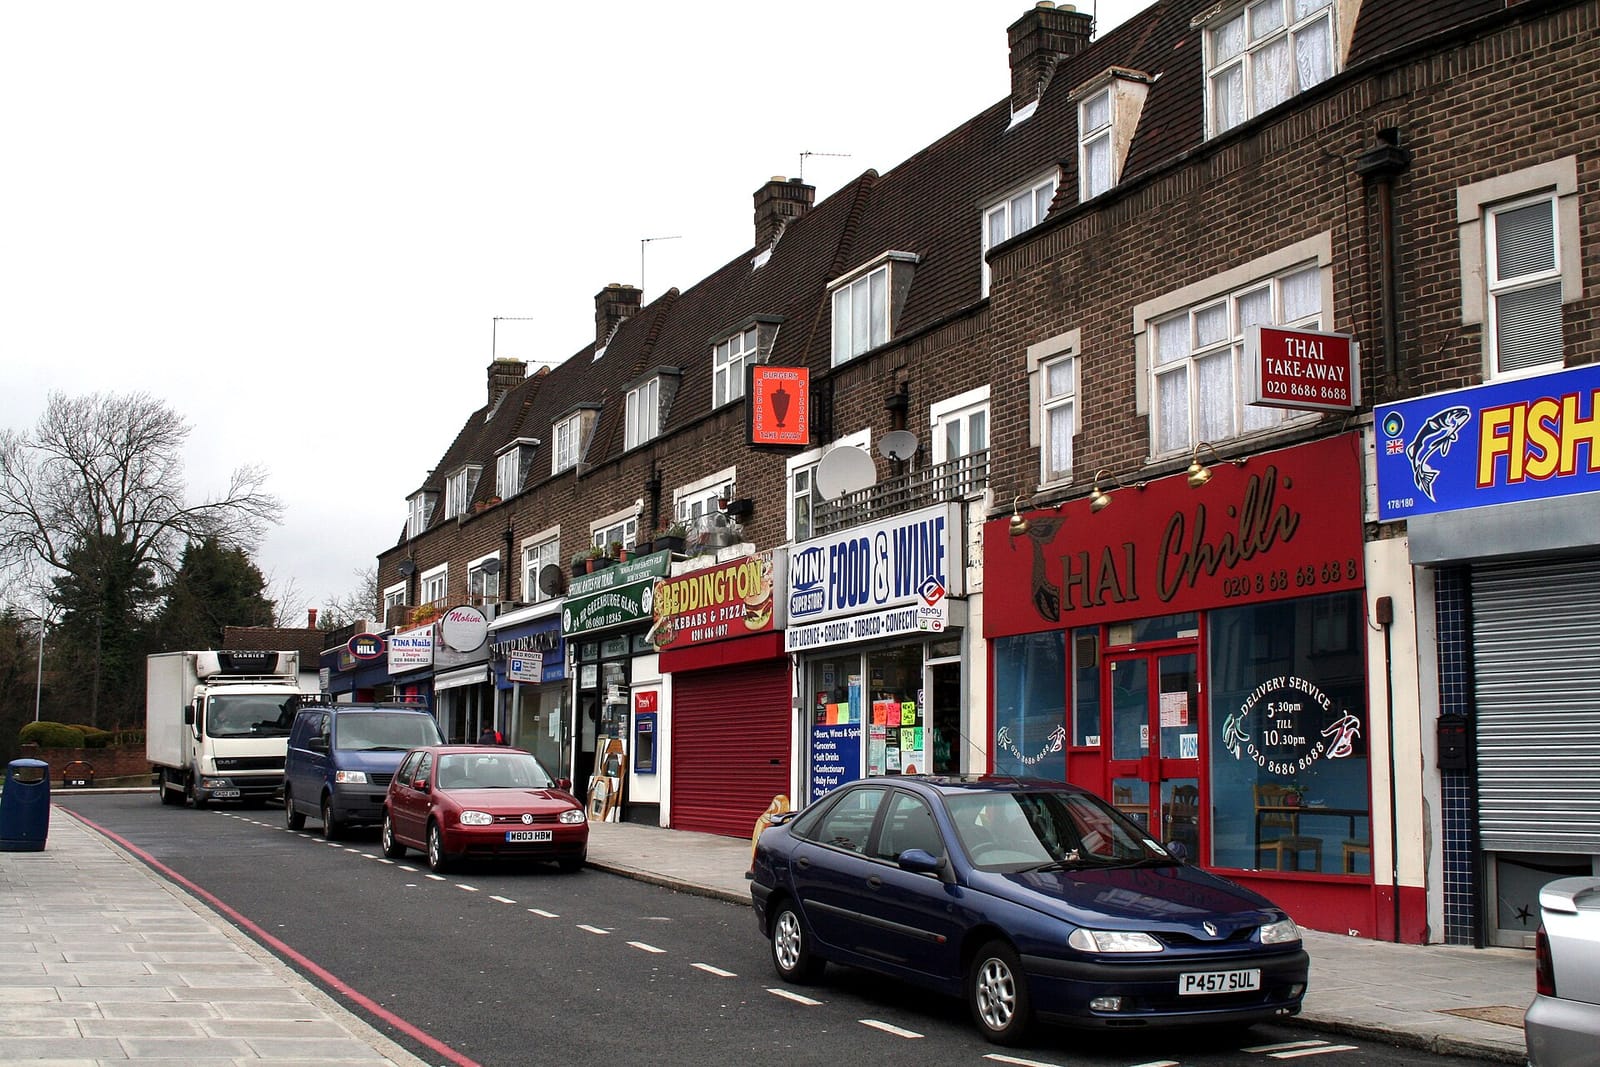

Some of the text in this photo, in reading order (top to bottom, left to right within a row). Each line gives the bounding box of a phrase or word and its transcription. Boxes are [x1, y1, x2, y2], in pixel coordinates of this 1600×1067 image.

[1285, 338, 1324, 360] THAI
[763, 371, 798, 379] BURGERS
[1266, 358, 1344, 381] TAKE-AWAY
[1267, 380, 1347, 400] 020 8686 8688
[1475, 388, 1600, 490] FISH
[1387, 498, 1414, 510] 178/180
[1155, 465, 1301, 603] Chilli
[792, 516, 945, 610] MINI FOOD & WINE
[1222, 559, 1358, 598] 020 8 68 68 68 8
[663, 560, 762, 616] BEDDINGTON
[621, 595, 638, 617] GLASS
[920, 608, 942, 618] epay
[450, 612, 481, 623] Mohini
[674, 604, 747, 630] KEBABS & PIZZA
[789, 631, 798, 648] OFF
[800, 627, 820, 646] LICENCE
[824, 622, 850, 642] GROCERY
[854, 616, 880, 638] TOBACCO
[356, 645, 376, 654] HILL
[514, 661, 520, 670] P
[1241, 676, 1331, 715] DELIVERY SERVICE
[1267, 701, 1301, 718] 5.30pm
[1276, 719, 1293, 729] TILL
[816, 730, 829, 739] Beers,
[1263, 730, 1306, 747] 10.30pm
[816, 741, 836, 750] Groceries
[825, 753, 839, 761] Drinks
[1247, 741, 1324, 775] 020 8686 8688
[816, 765, 845, 774] Confectionary
[816, 776, 838, 786] Baby Food
[511, 832, 533, 840] W803
[1186, 972, 1254, 992] P457 SUL
